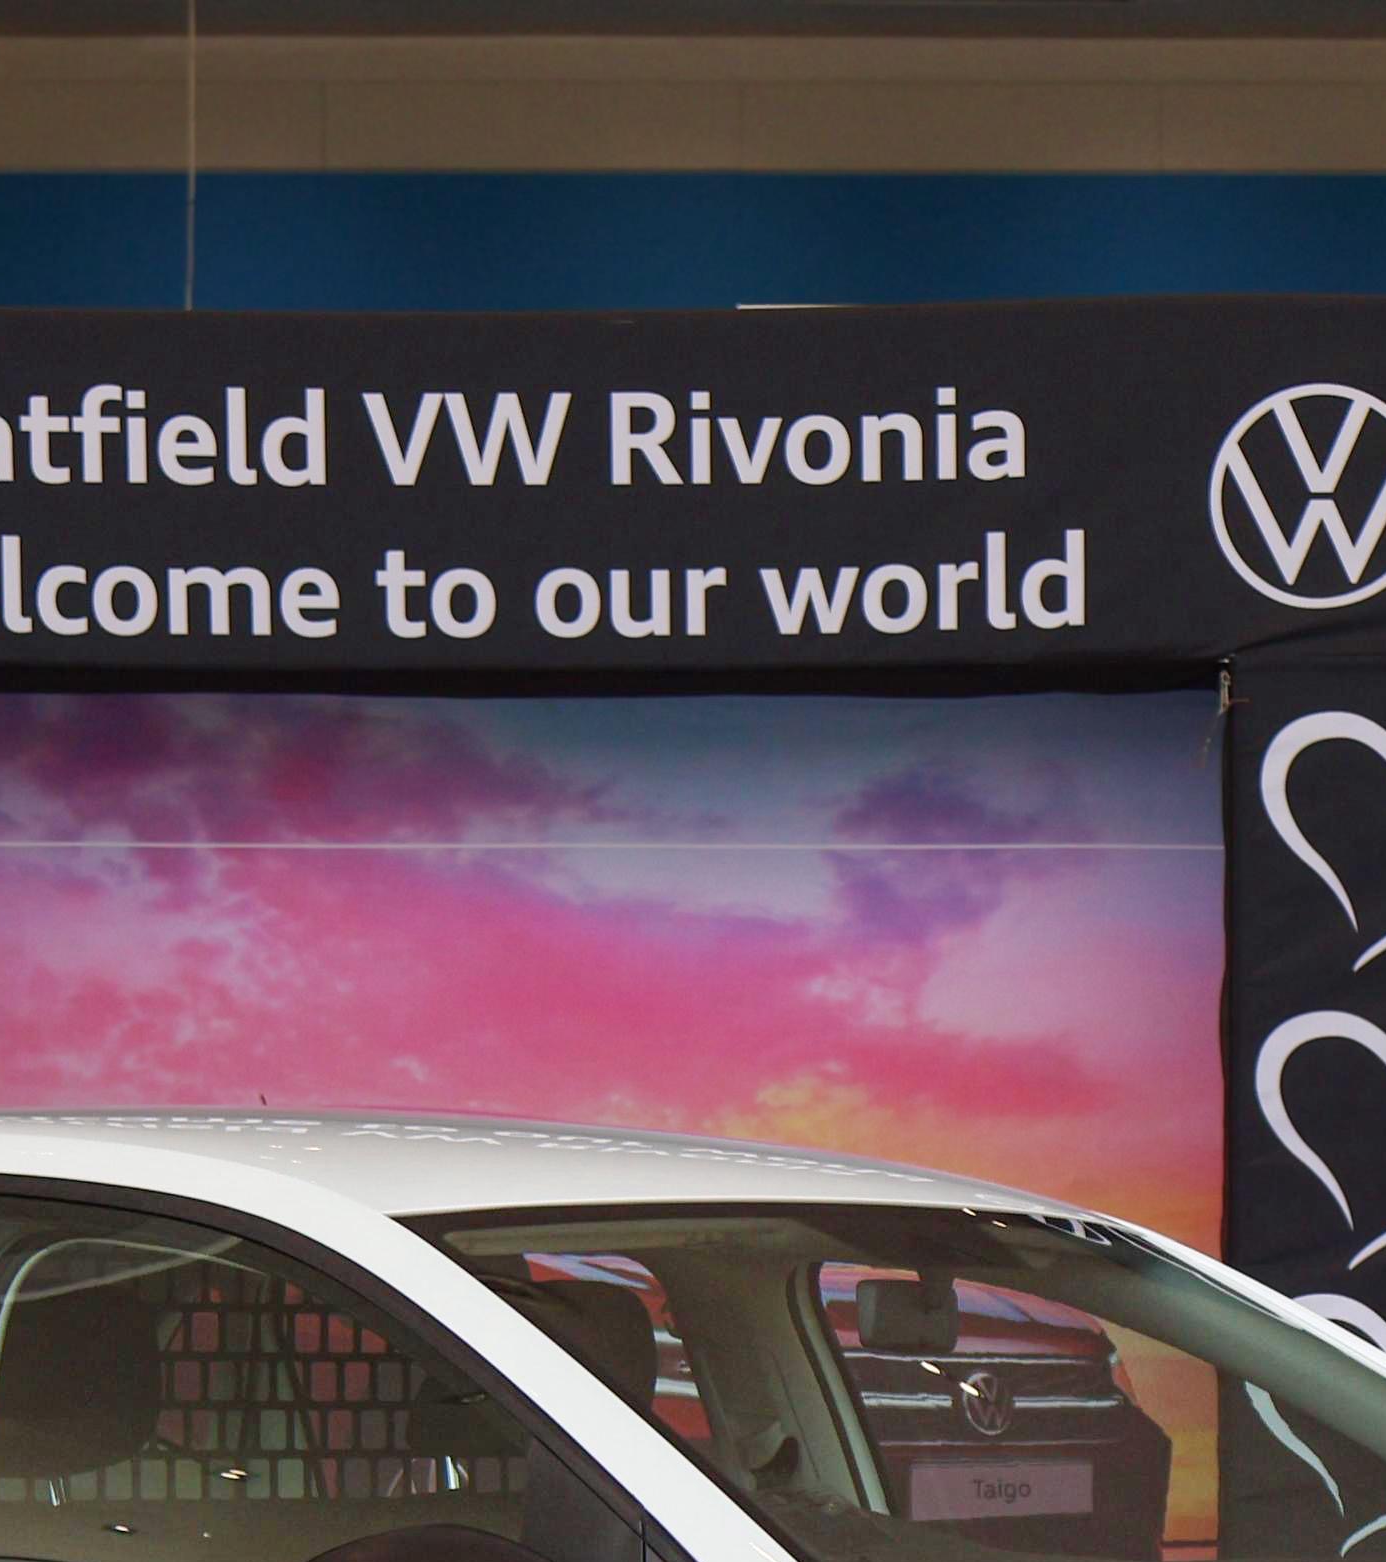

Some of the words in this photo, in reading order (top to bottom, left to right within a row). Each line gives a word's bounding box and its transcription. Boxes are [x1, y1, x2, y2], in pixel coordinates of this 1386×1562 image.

[362, 392, 572, 486] VW
[610, 387, 1025, 485] Rivonia
[375, 550, 496, 639] to
[535, 567, 727, 638] our
[759, 529, 1085, 635] world
[972, 1478, 1032, 1504] Taigo
